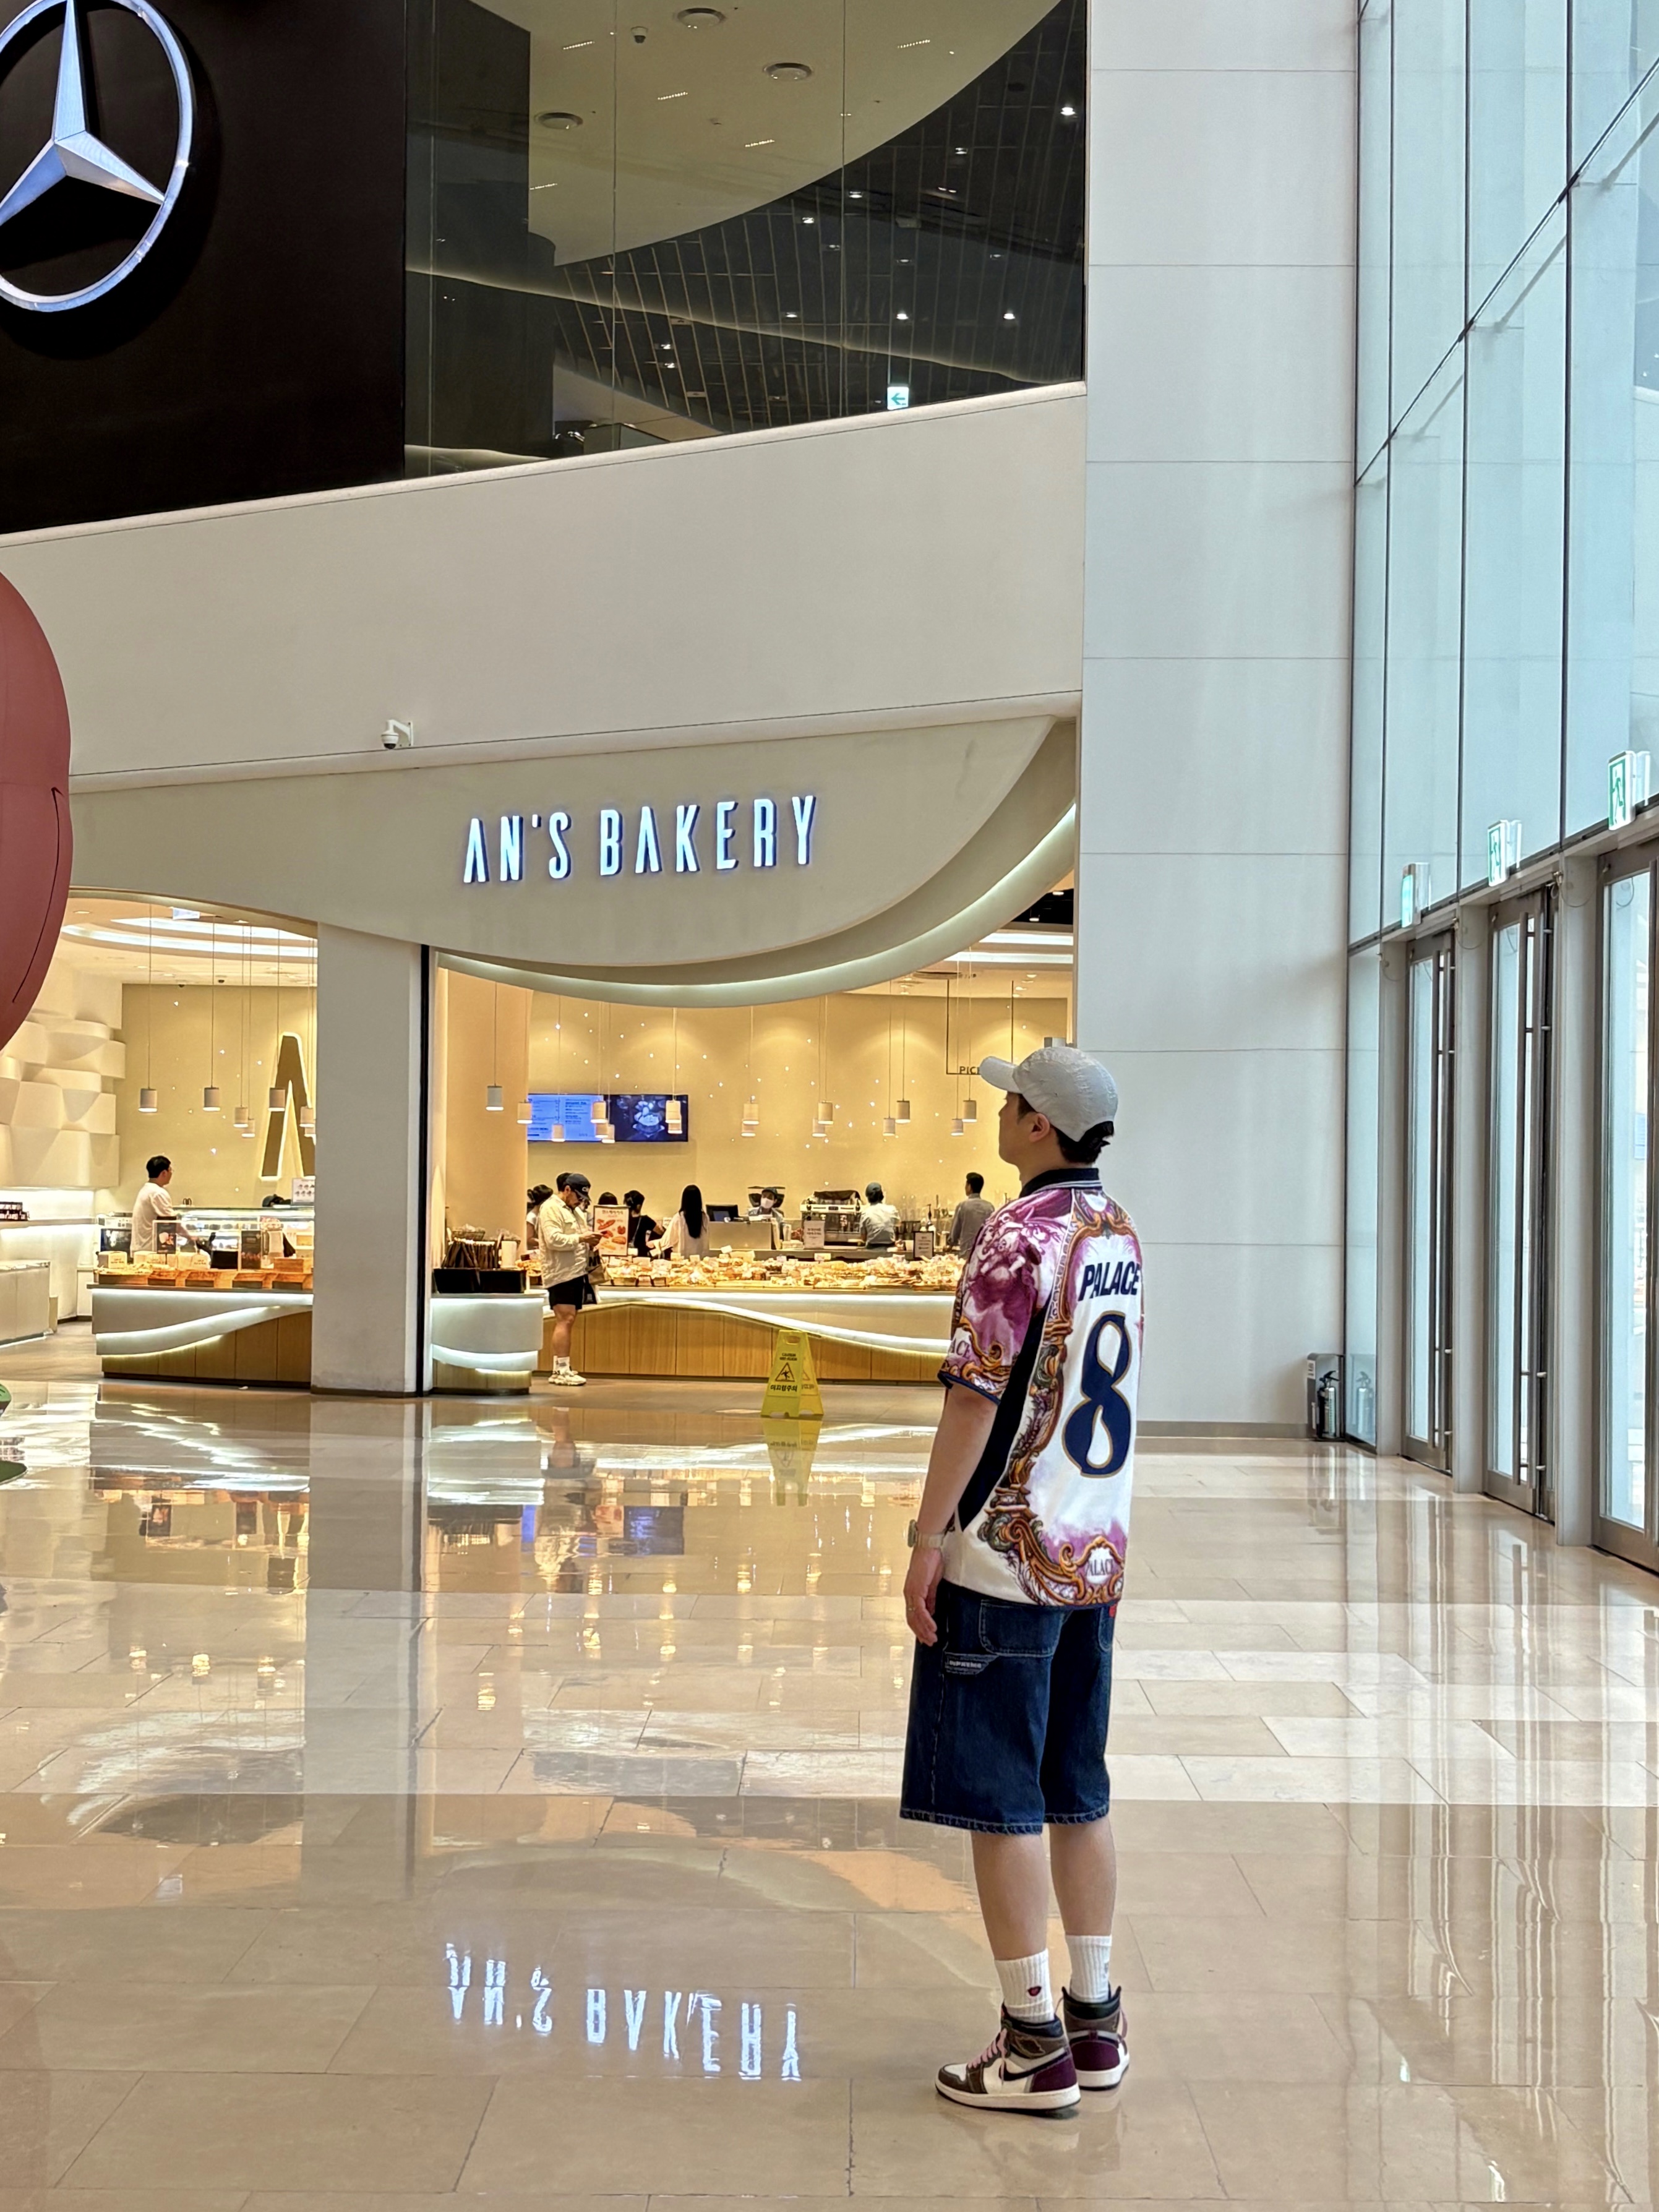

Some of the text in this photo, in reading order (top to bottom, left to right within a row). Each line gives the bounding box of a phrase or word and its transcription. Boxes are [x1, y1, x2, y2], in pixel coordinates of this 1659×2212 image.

[463, 795, 817, 883] AN'S BAKERY
[1078, 1261, 1141, 1301] PALACE
[1062, 1311, 1132, 1478] 8
